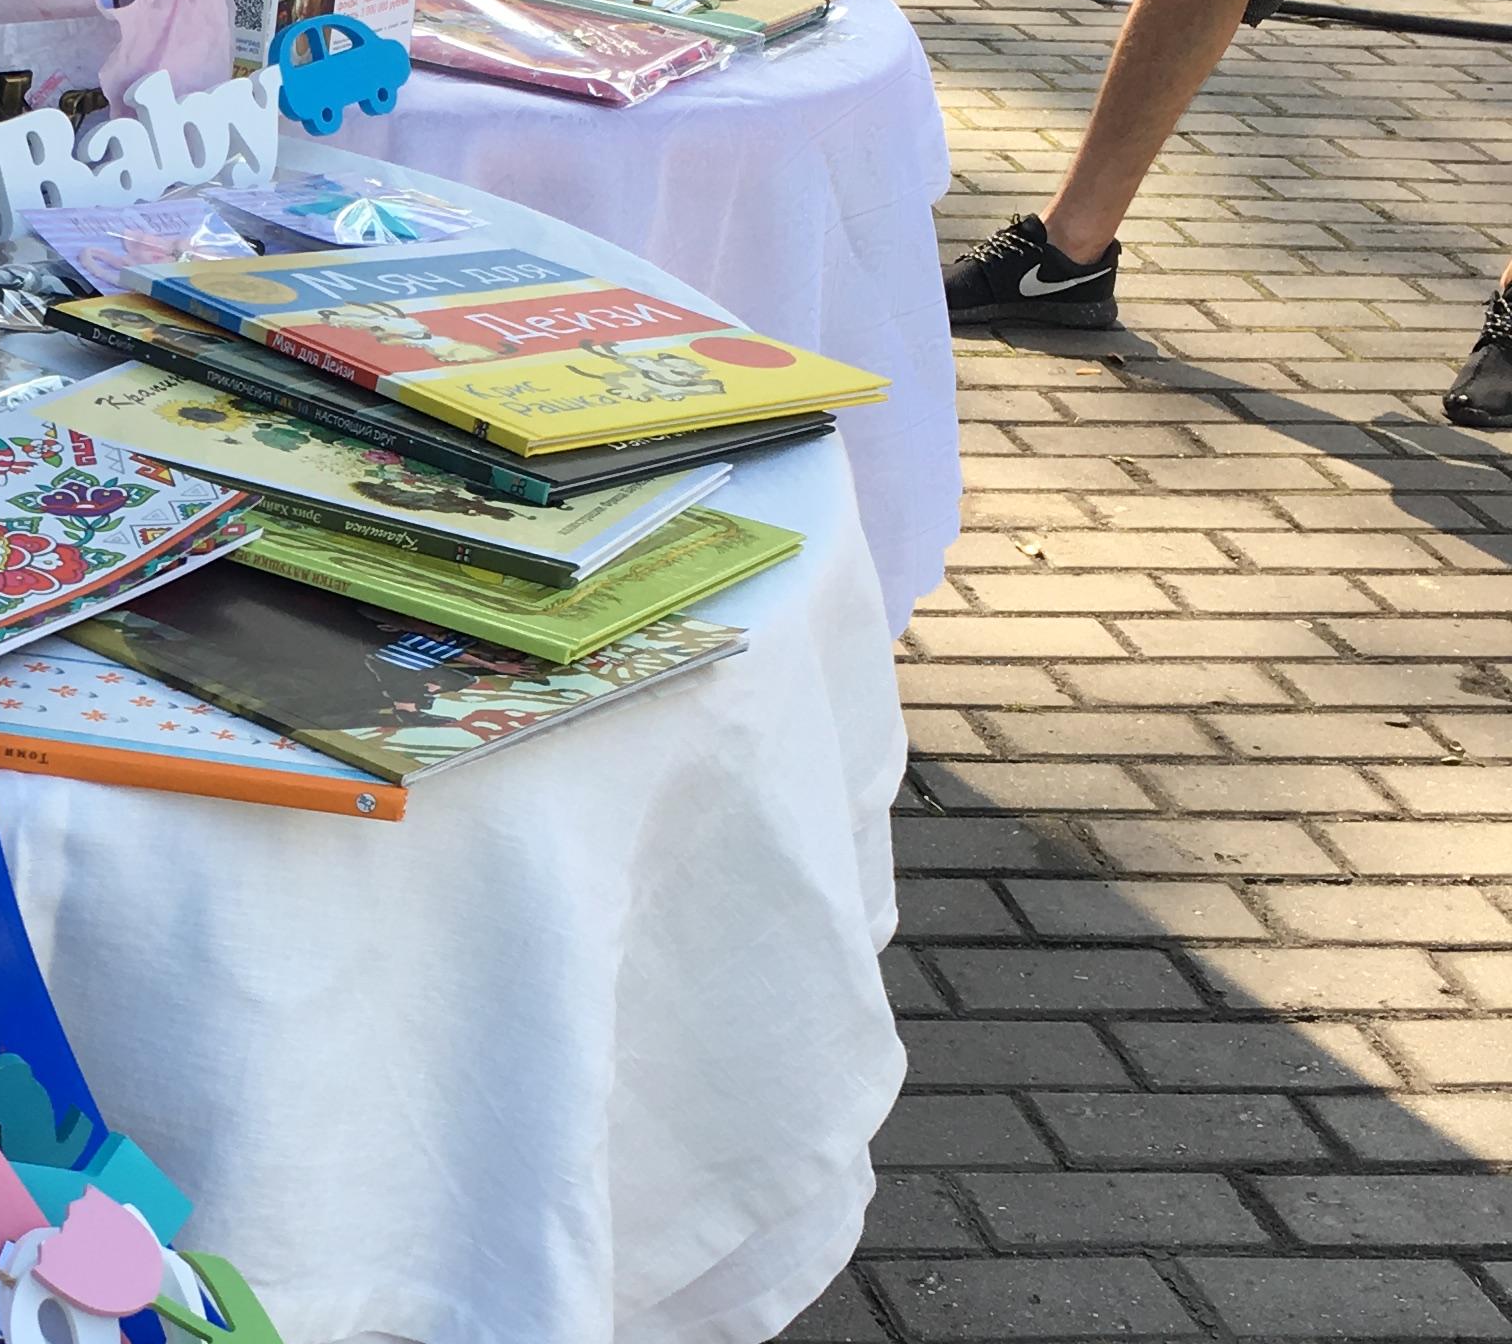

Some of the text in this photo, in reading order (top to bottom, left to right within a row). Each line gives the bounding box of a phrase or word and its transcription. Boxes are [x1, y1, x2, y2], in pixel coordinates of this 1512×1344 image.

[291, 263, 561, 300] Мяч для
[464, 302, 683, 345] Дейзи
[272, 333, 356, 381] Мяч для Дейзи
[206, 370, 273, 402] ПРИКЛЮЧЕНИЯ
[314, 408, 373, 440] НАСТОЯЩИЙ
[457, 380, 552, 401] Крис
[292, 507, 322, 525] Эрих
[344, 520, 419, 552] Крапинка
